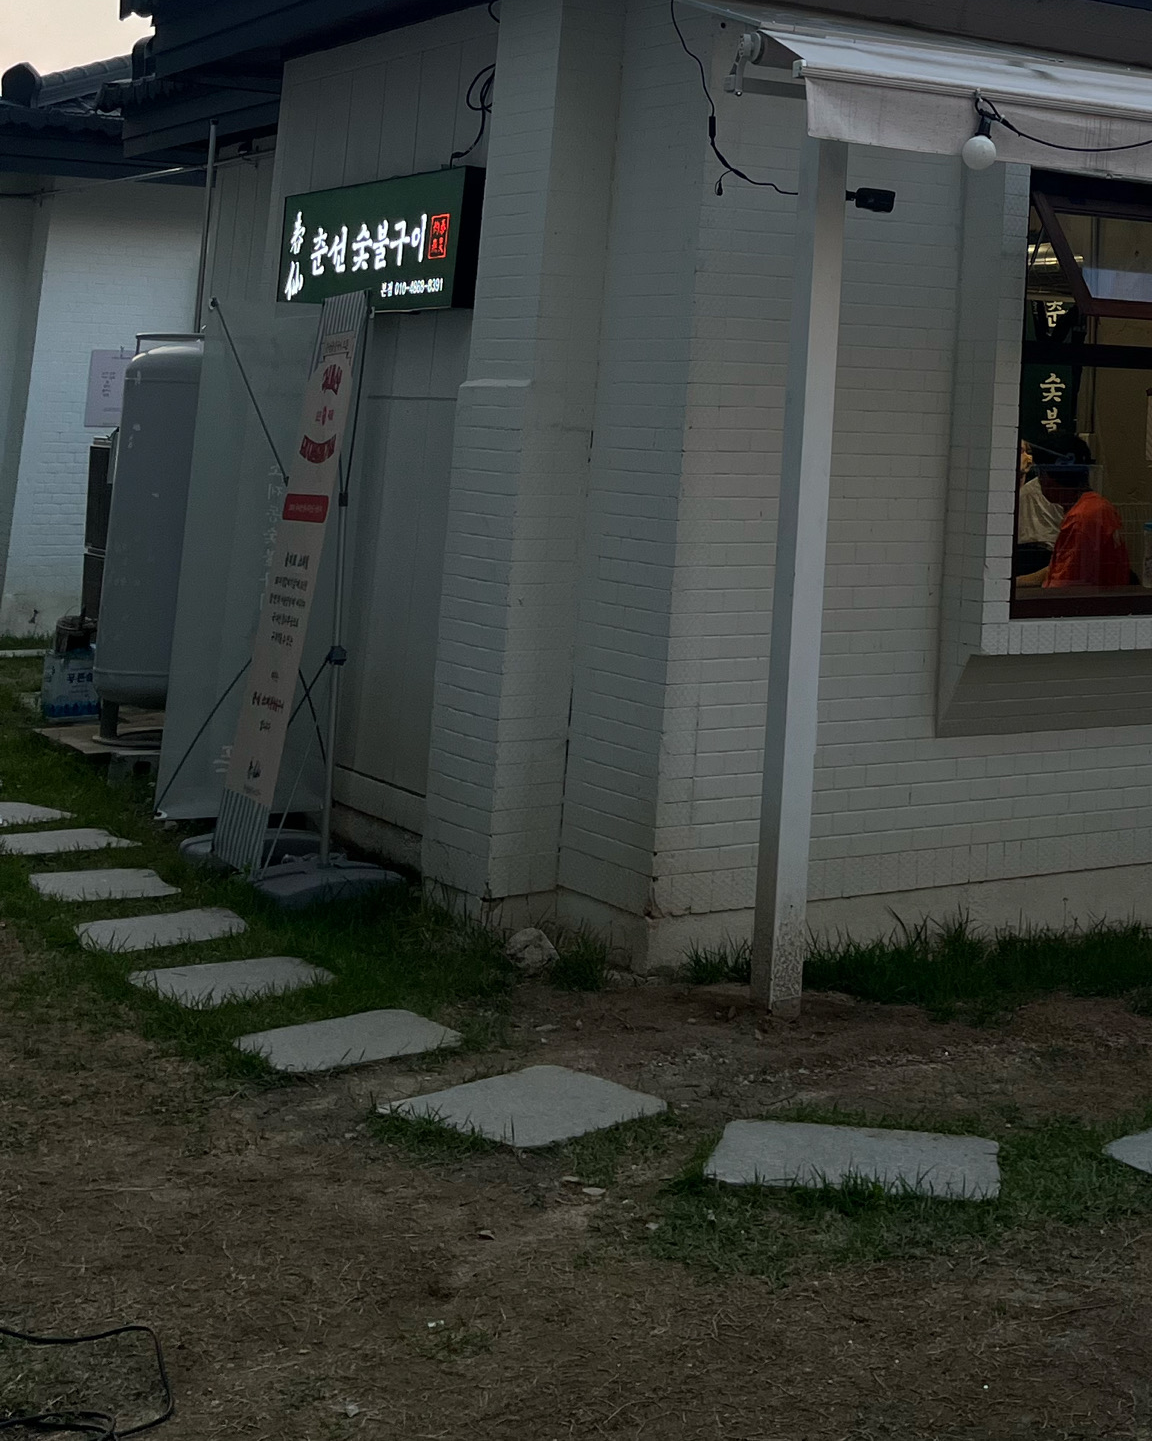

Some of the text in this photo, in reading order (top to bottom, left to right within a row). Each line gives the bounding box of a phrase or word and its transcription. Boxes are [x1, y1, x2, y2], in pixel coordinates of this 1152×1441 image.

[310, 223, 348, 276] 춘선
[351, 213, 427, 272] 숯불구이
[380, 280, 393, 298] 본점
